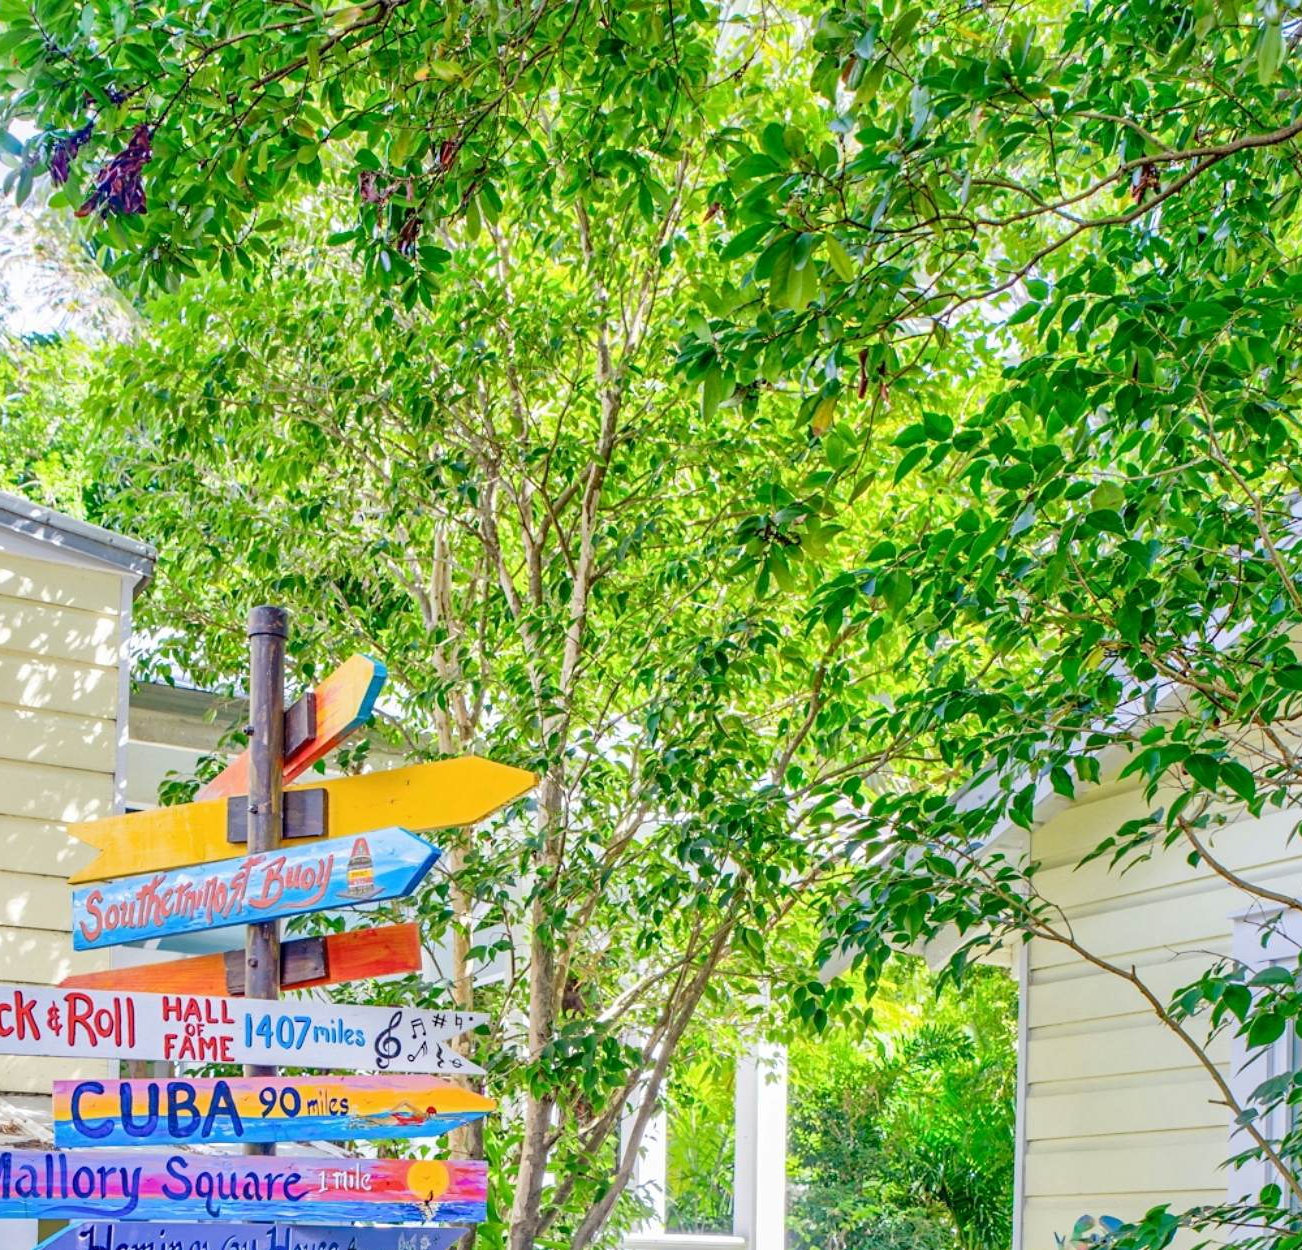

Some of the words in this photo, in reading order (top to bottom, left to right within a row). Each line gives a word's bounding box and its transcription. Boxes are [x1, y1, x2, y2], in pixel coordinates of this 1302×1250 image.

[80, 854, 266, 942] Southernmost
[249, 854, 334, 910] Buoy
[47, 1001, 63, 1037] &
[63, 992, 135, 1048] Roll
[162, 996, 235, 1024] HALL
[185, 1023, 205, 1037] OF
[245, 1013, 312, 1049] 1407
[313, 1018, 365, 1047] miles
[164, 1034, 235, 1062] FAME
[71, 1080, 245, 1139] CUBA
[258, 1086, 302, 1119] 90
[307, 1089, 350, 1116] miles
[161, 1155, 310, 1218] Square
[318, 1171, 328, 1193] 1
